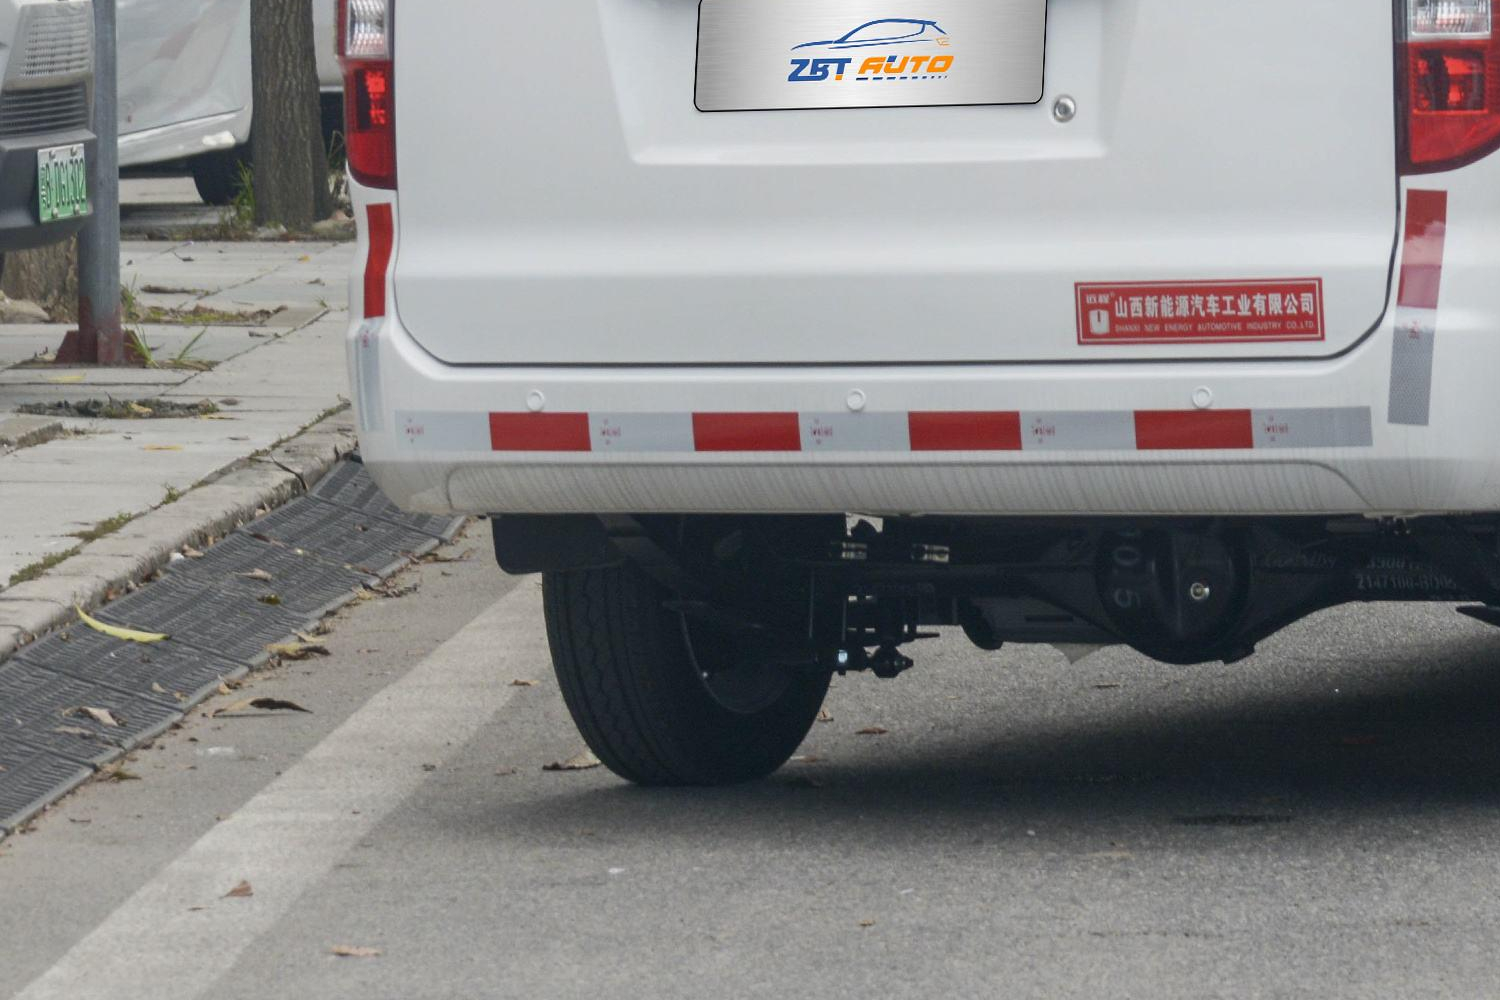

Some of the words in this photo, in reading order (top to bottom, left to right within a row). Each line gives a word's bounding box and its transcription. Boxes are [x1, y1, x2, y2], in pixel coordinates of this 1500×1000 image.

[1114, 292, 1315, 318] 山西新能源汽车工业有限公司
